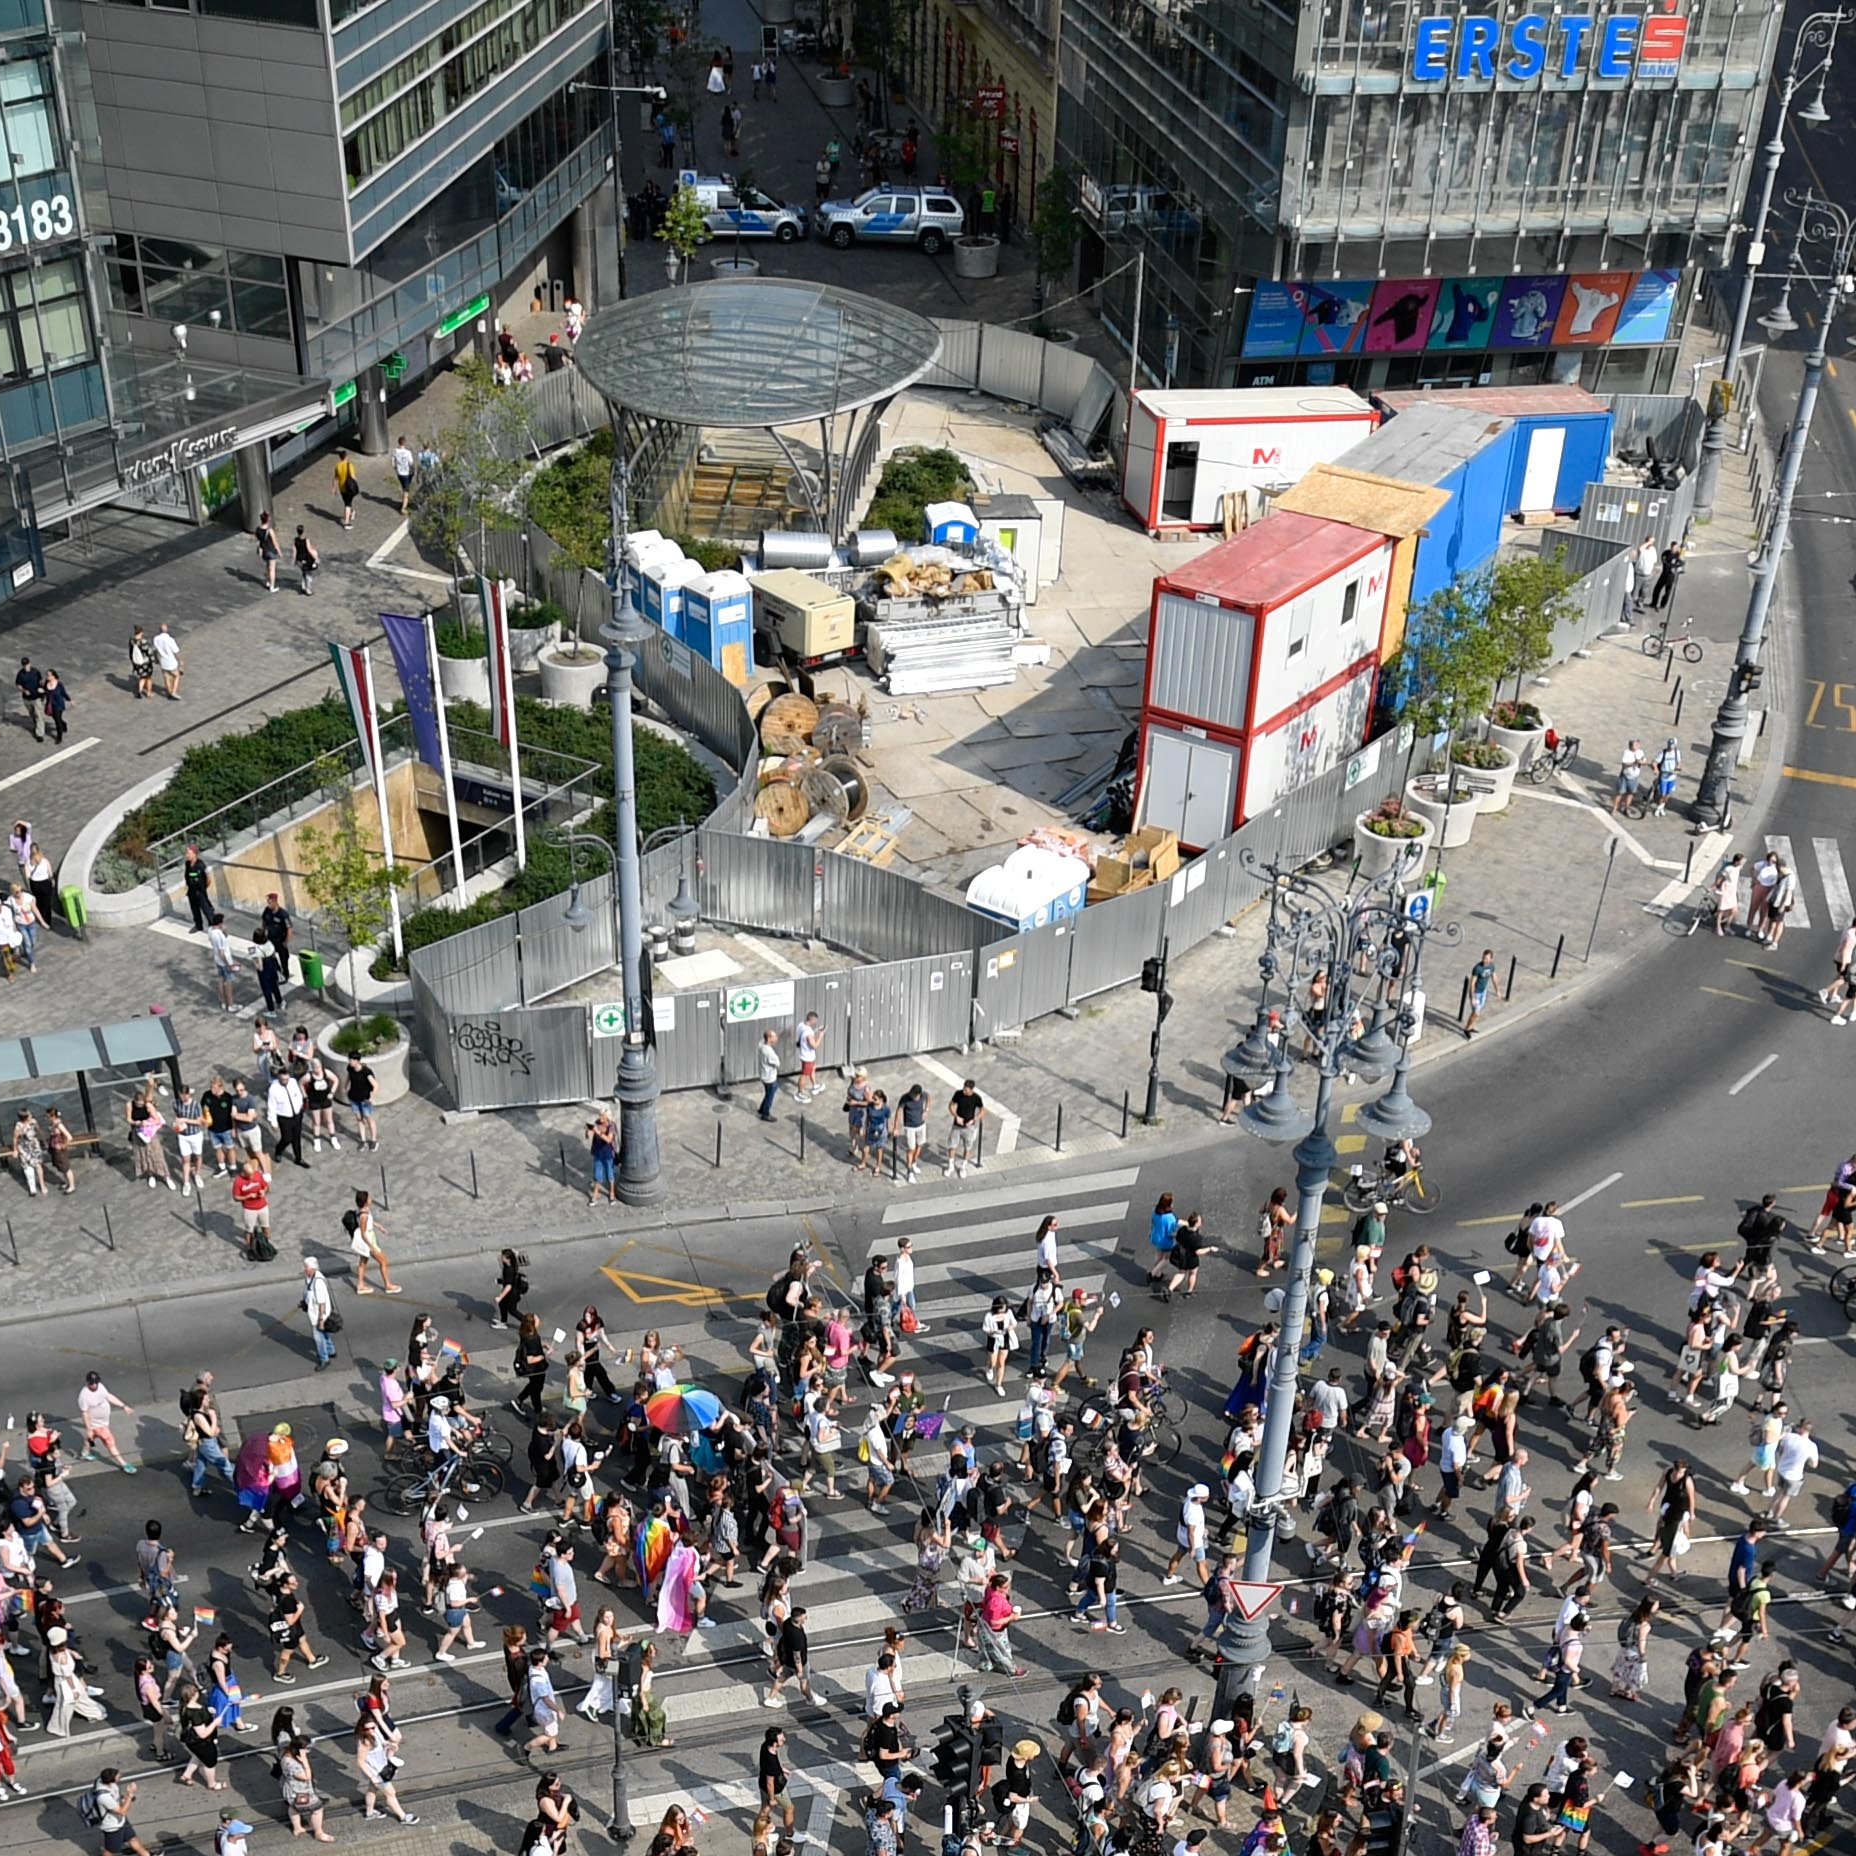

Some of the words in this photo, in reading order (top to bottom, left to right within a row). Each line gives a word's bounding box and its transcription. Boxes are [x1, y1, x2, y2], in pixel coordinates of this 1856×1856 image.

[1413, 14, 1639, 80] ERSTE
[1639, 63, 1678, 77] BANK
[1252, 375, 1275, 386] ATM
